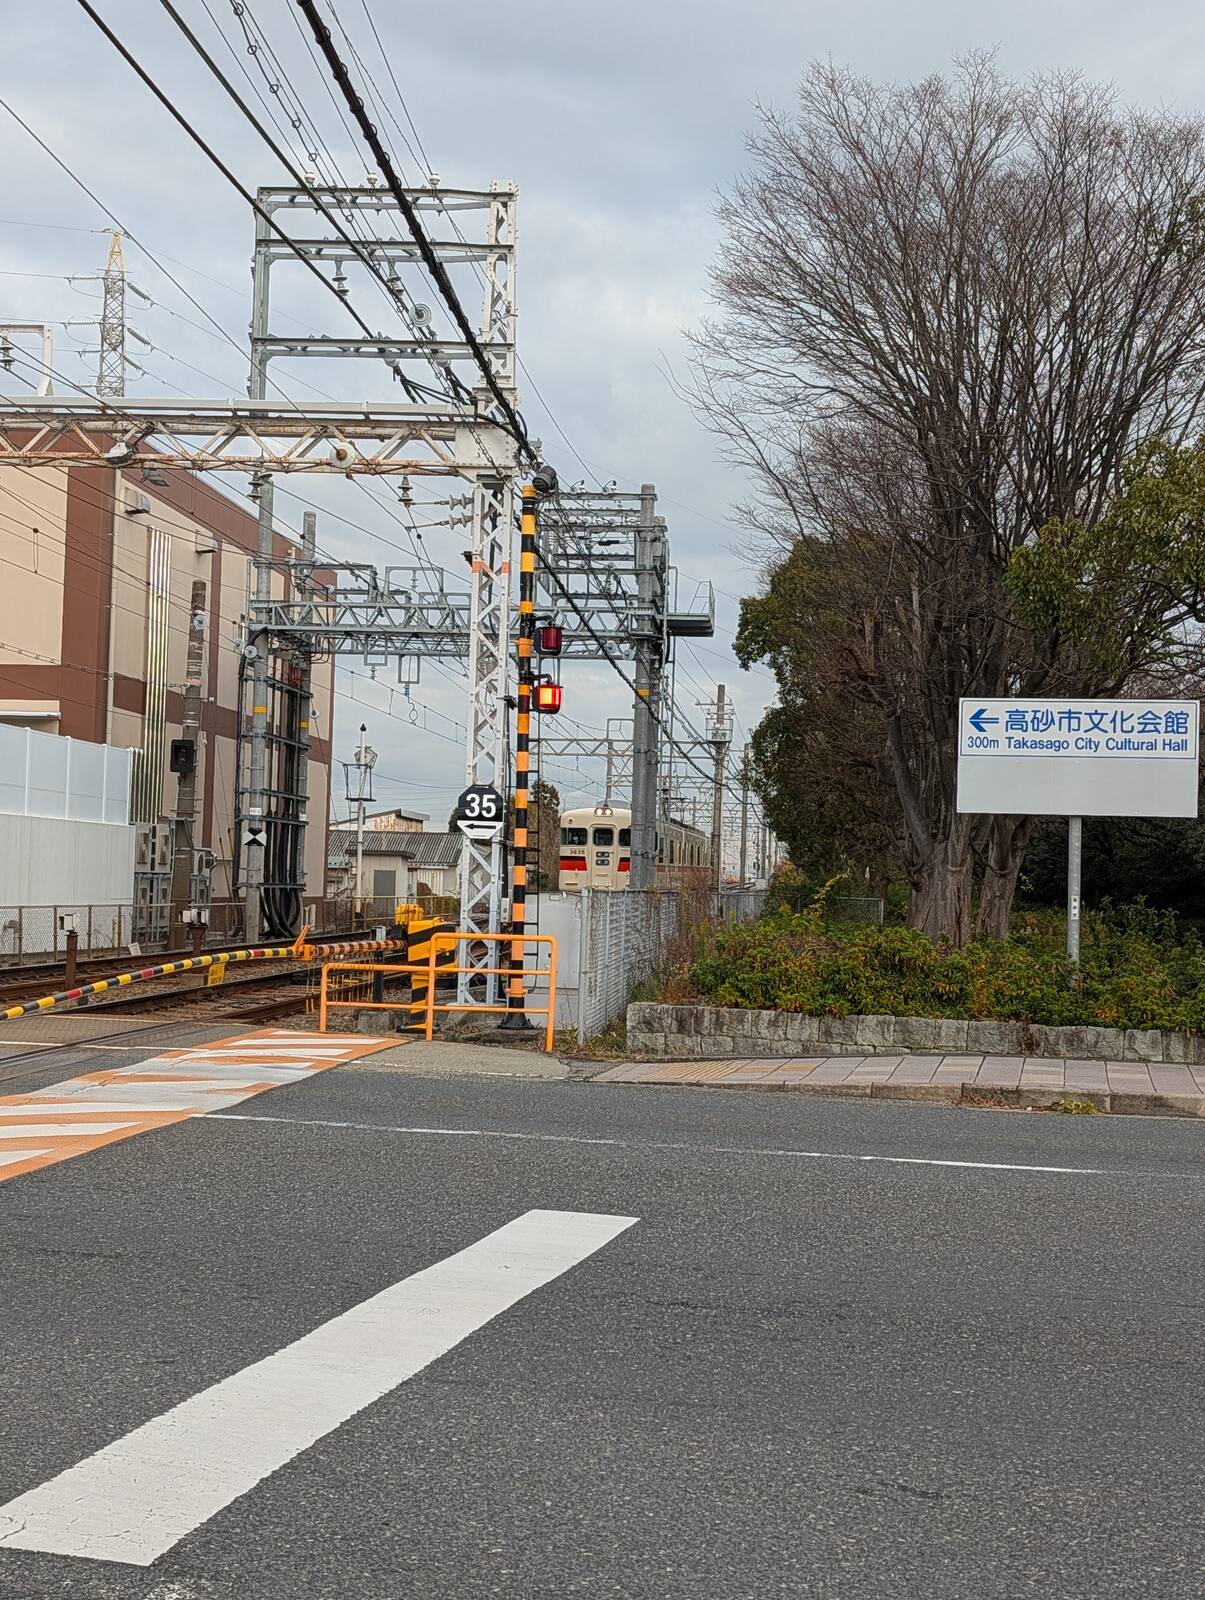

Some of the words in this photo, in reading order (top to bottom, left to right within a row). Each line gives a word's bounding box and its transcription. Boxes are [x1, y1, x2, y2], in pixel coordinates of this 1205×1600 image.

[1004, 708, 1190, 735] 高砂市文化会館
[967, 736, 1000, 749] 300m
[1005, 737, 1070, 752] Takasago
[1075, 737, 1100, 753] City
[1106, 737, 1158, 752] Cultural
[1162, 738, 1188, 752] Hall
[465, 793, 496, 818] 35
